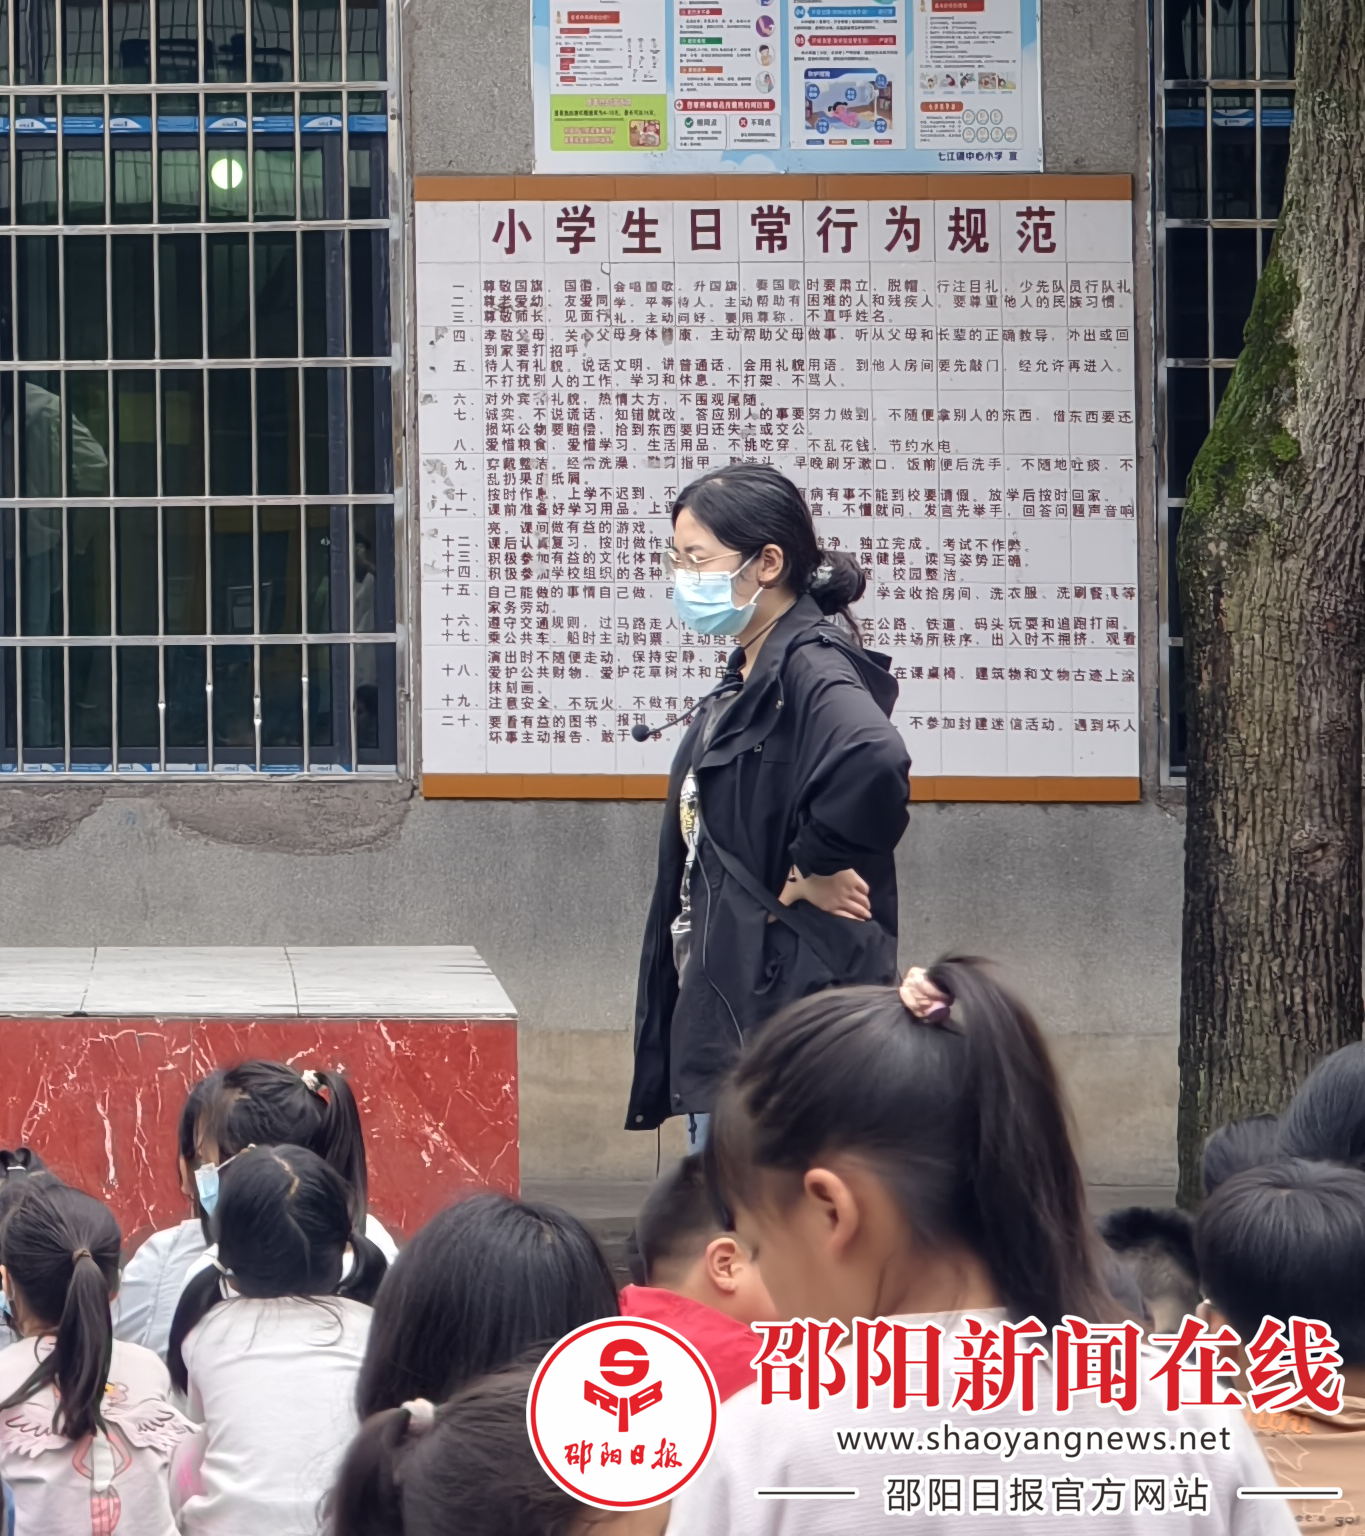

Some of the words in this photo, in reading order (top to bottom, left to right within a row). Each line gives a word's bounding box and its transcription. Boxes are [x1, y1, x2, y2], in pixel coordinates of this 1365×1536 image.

[491, 205, 1058, 255] 小学生日常行为规范
